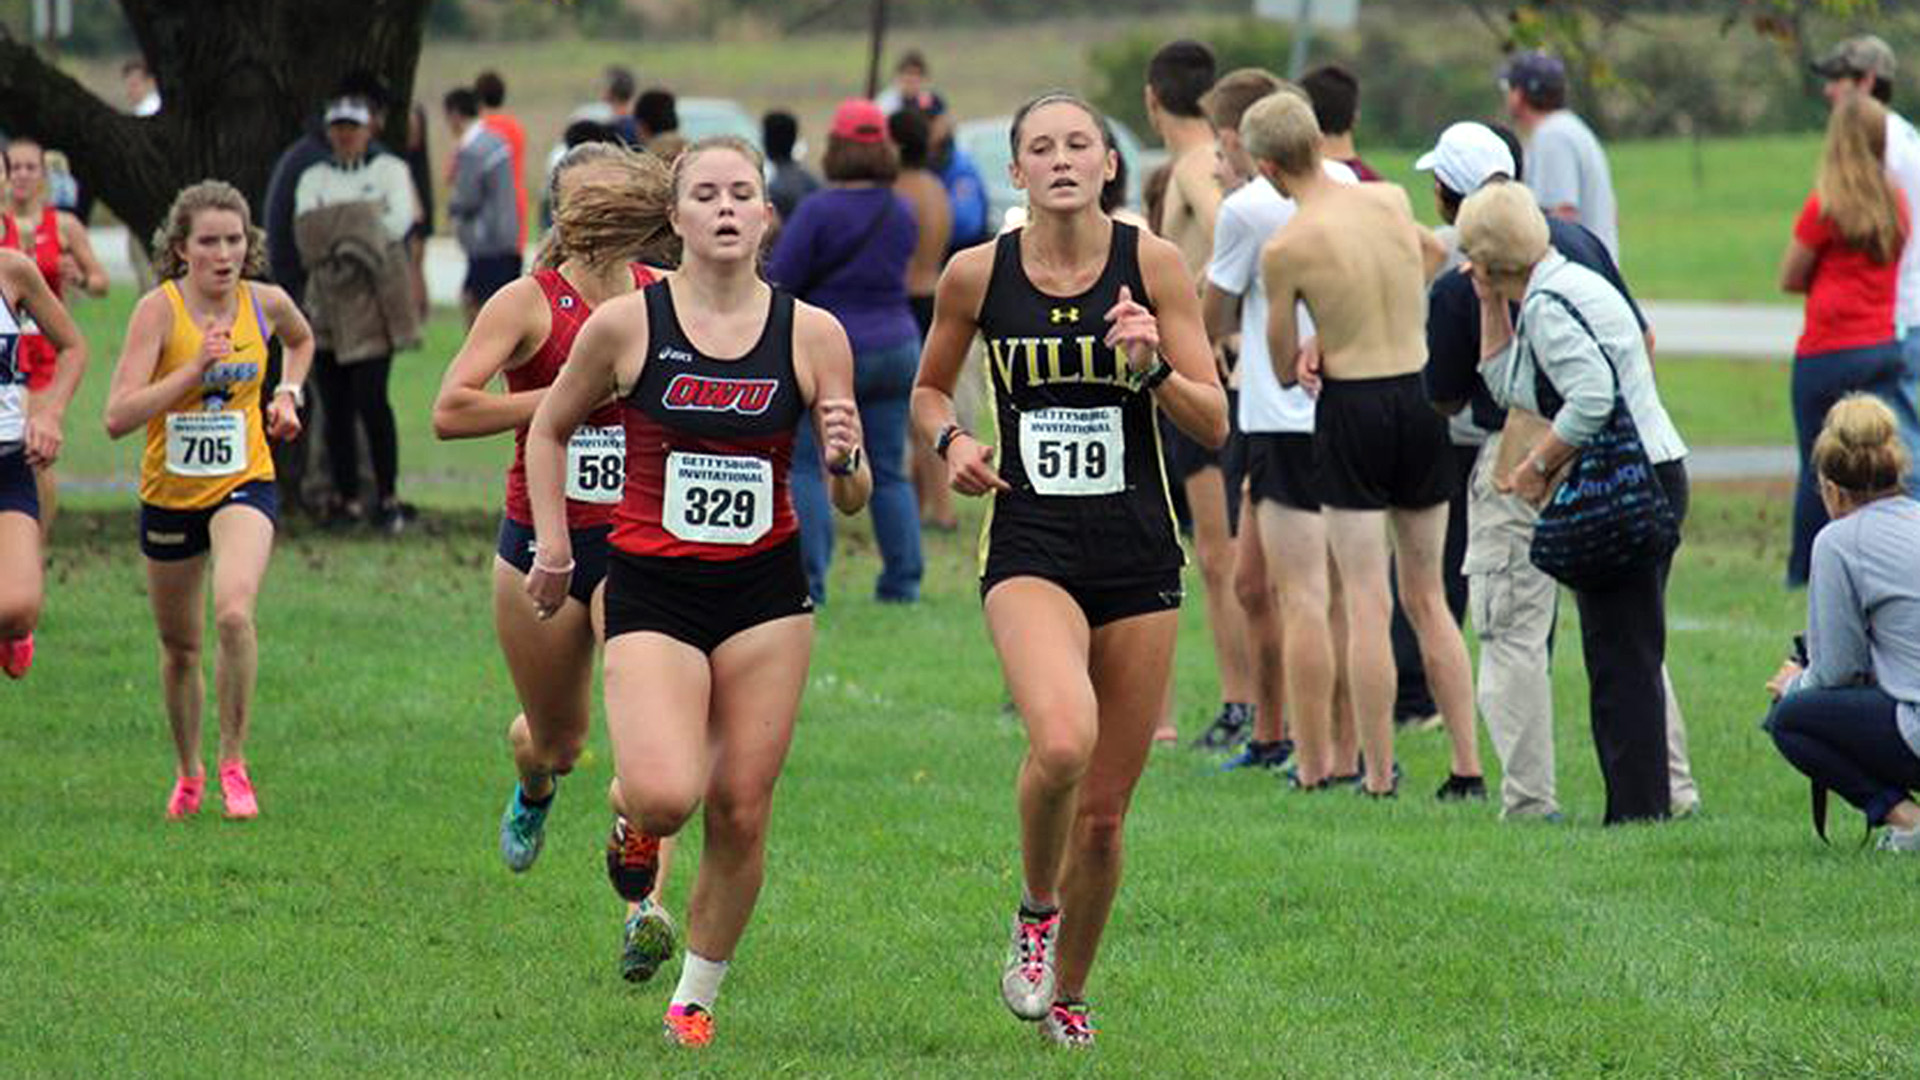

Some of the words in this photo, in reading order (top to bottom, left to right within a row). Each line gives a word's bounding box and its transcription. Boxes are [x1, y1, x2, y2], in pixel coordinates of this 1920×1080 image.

[662, 373, 779, 414] OWU
[1031, 422, 1112, 434] INVITATIONAL
[1034, 408, 1110, 421] GETTYSBURG
[181, 437, 233, 465] 705
[682, 456, 762, 469] GETTYSBURG
[1038, 441, 1107, 479] 519
[578, 454, 626, 491] 58
[678, 468, 763, 483] INVITATIONAL
[685, 487, 755, 528] 329
